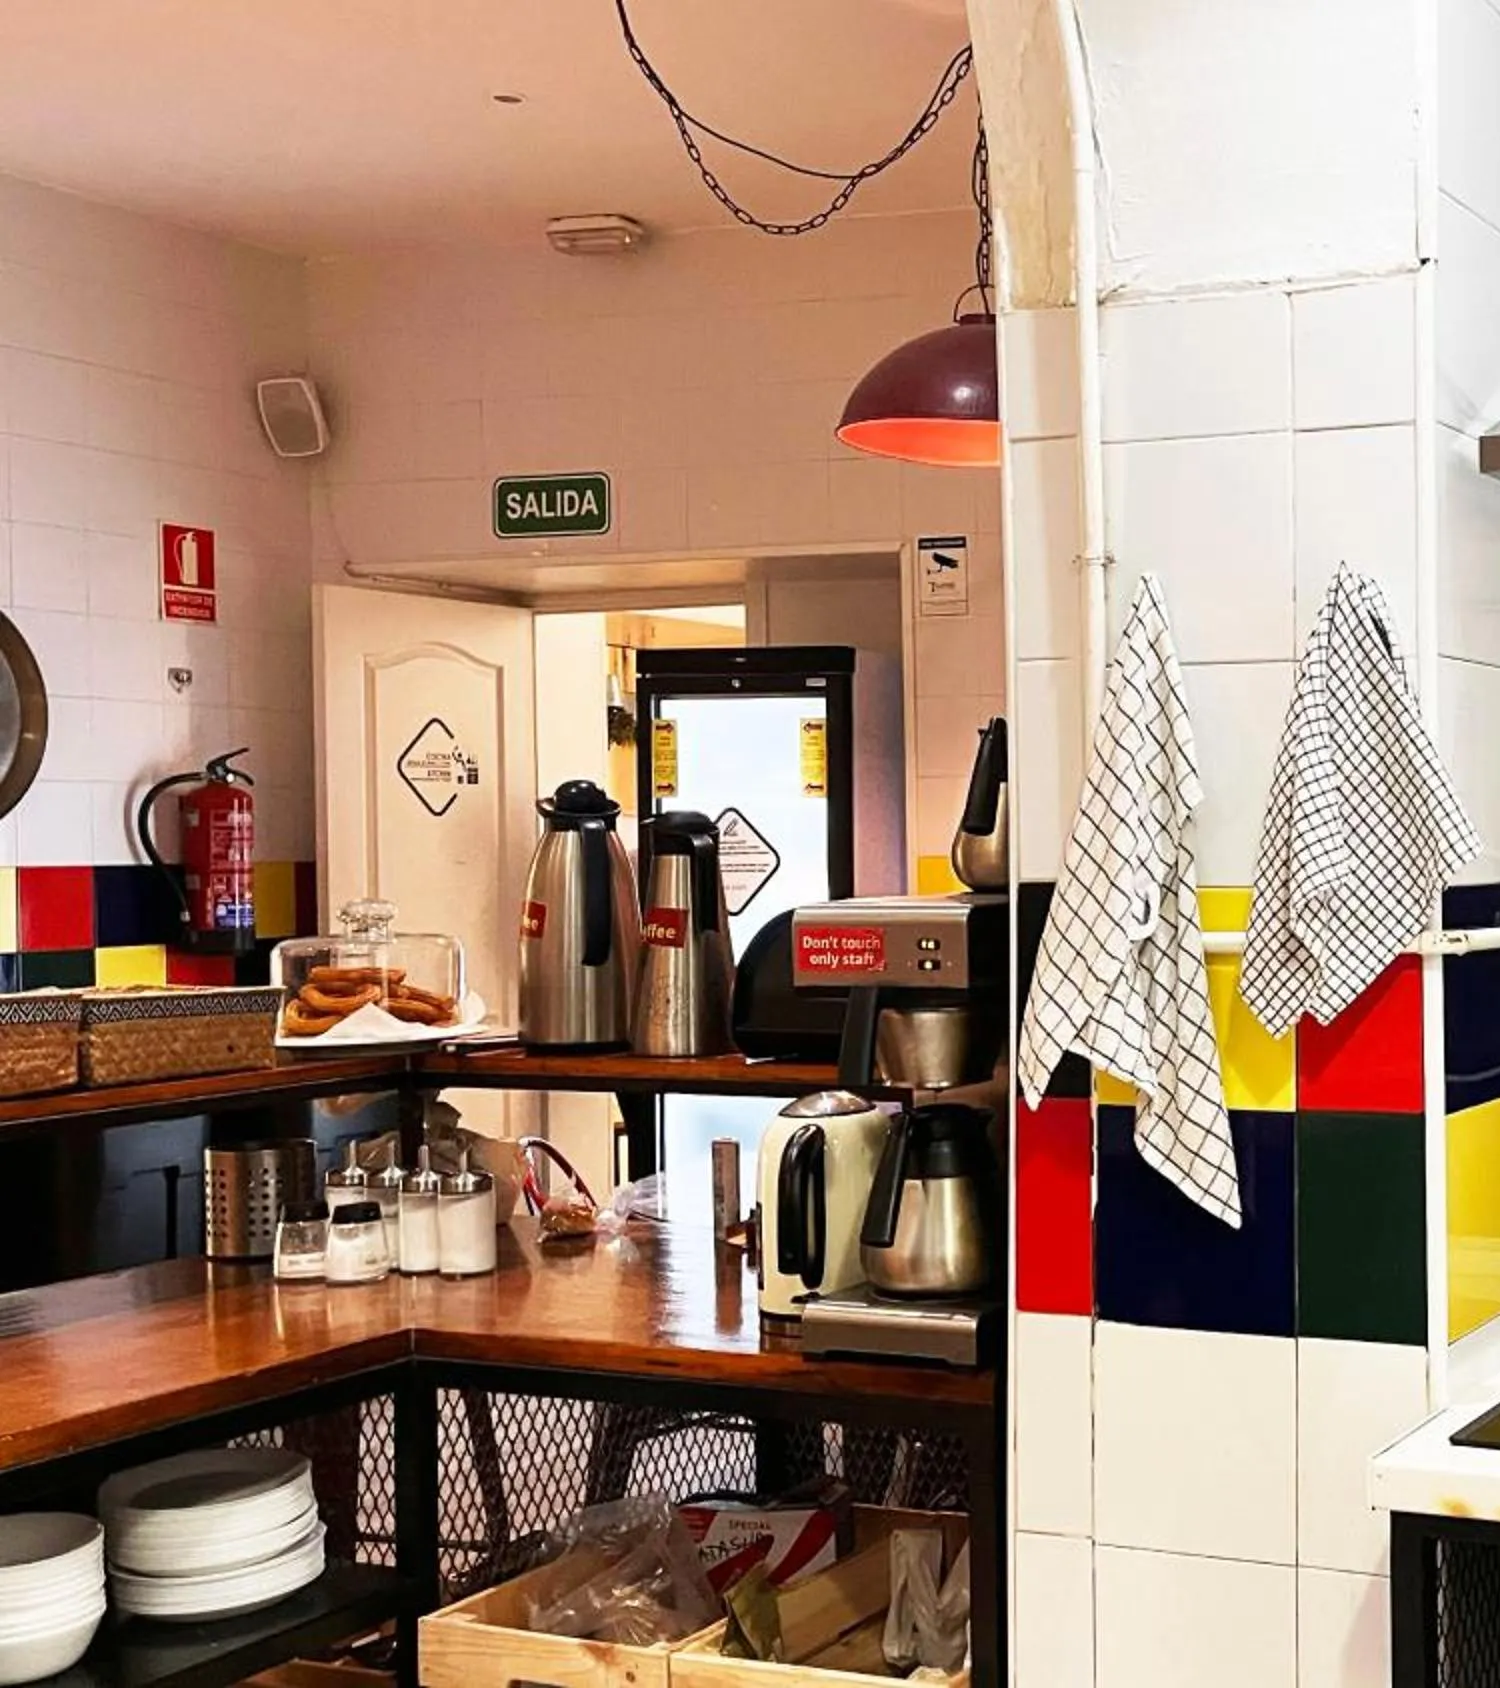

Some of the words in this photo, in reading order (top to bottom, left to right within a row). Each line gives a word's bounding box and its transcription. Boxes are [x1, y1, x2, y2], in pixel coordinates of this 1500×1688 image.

[506, 489, 599, 519] SALIDA
[803, 935, 838, 949] Don't
[841, 935, 881, 949] touch
[809, 951, 839, 969] only
[842, 952, 874, 965] staff
[729, 1519, 771, 1530] SPECIAL
